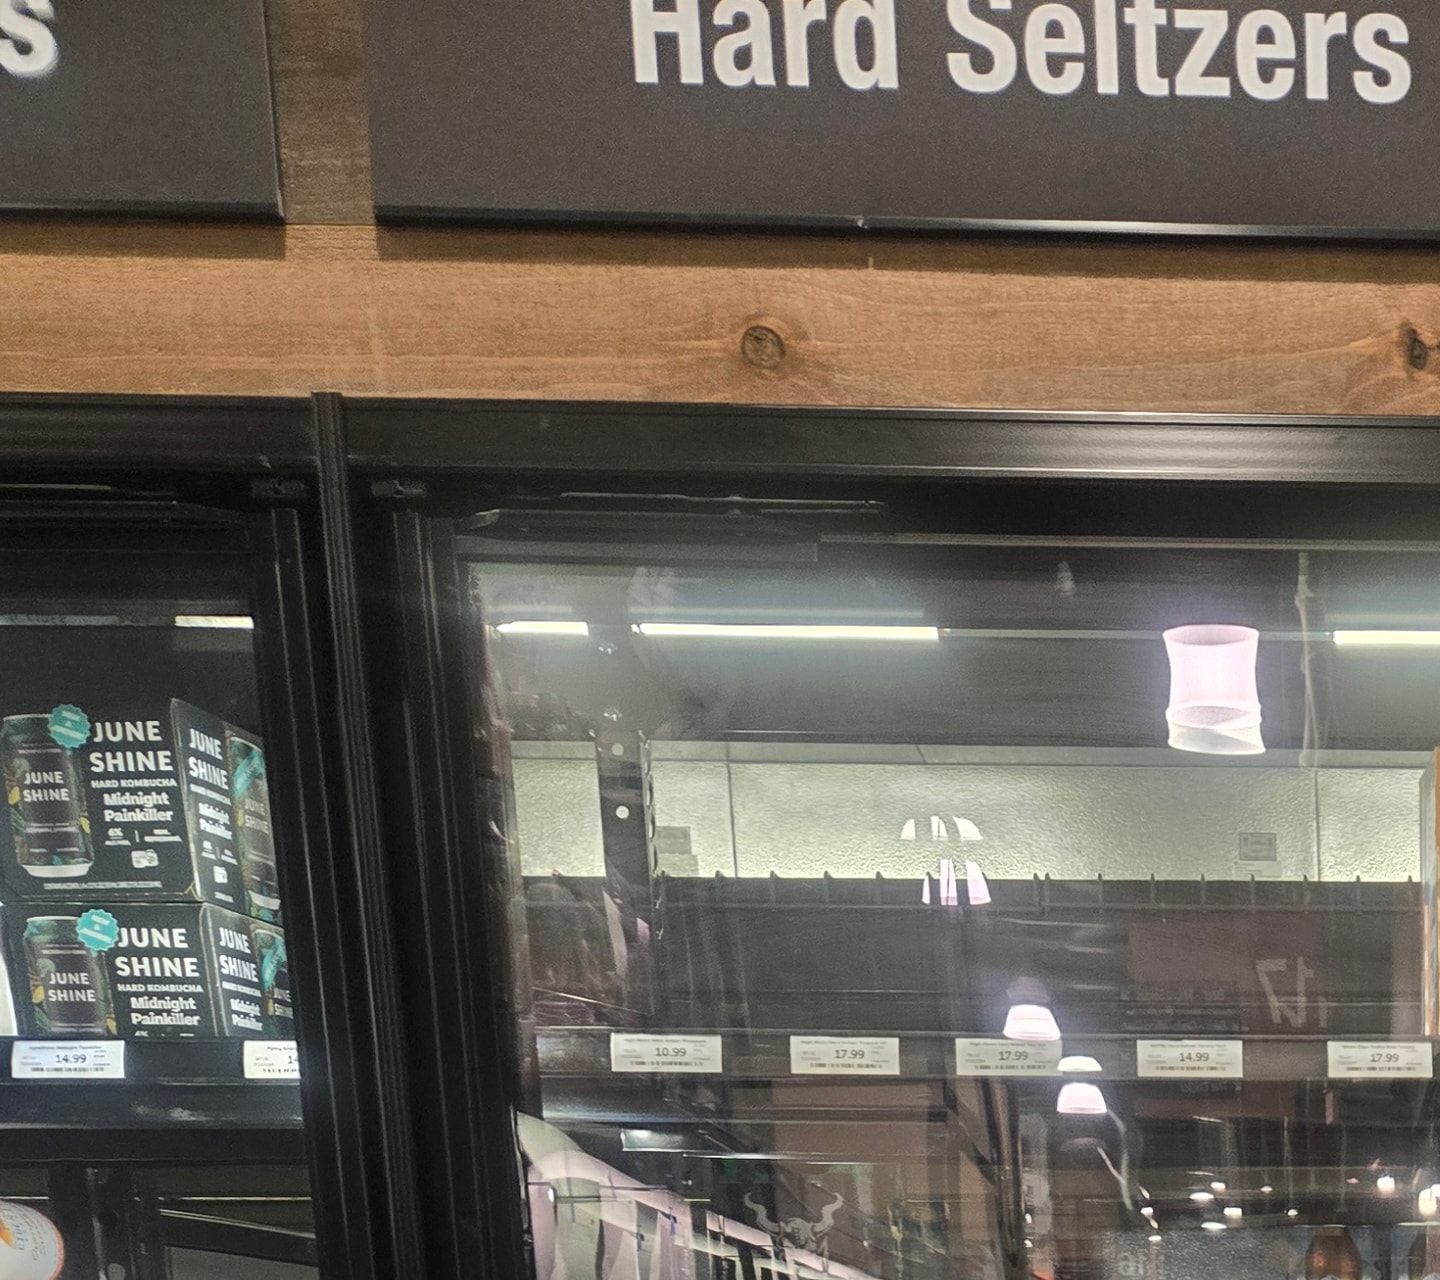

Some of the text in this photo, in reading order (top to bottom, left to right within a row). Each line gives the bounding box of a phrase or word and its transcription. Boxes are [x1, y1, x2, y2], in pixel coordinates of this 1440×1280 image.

[630, 0, 1412, 103] Hard Seltzers
[93, 721, 162, 742] JUNE
[89, 751, 173, 773] SHINE
[92, 778, 177, 789] HARD KOMBUCHA
[104, 792, 169, 807] Midnight
[104, 808, 173, 823] Painkiller
[117, 928, 189, 949] JUNE
[115, 957, 200, 978] SHINE
[54, 1053, 87, 1064] 14.99
[655, 1047, 687, 1058] 10.99
[1178, 1052, 1210, 1063] 14.99
